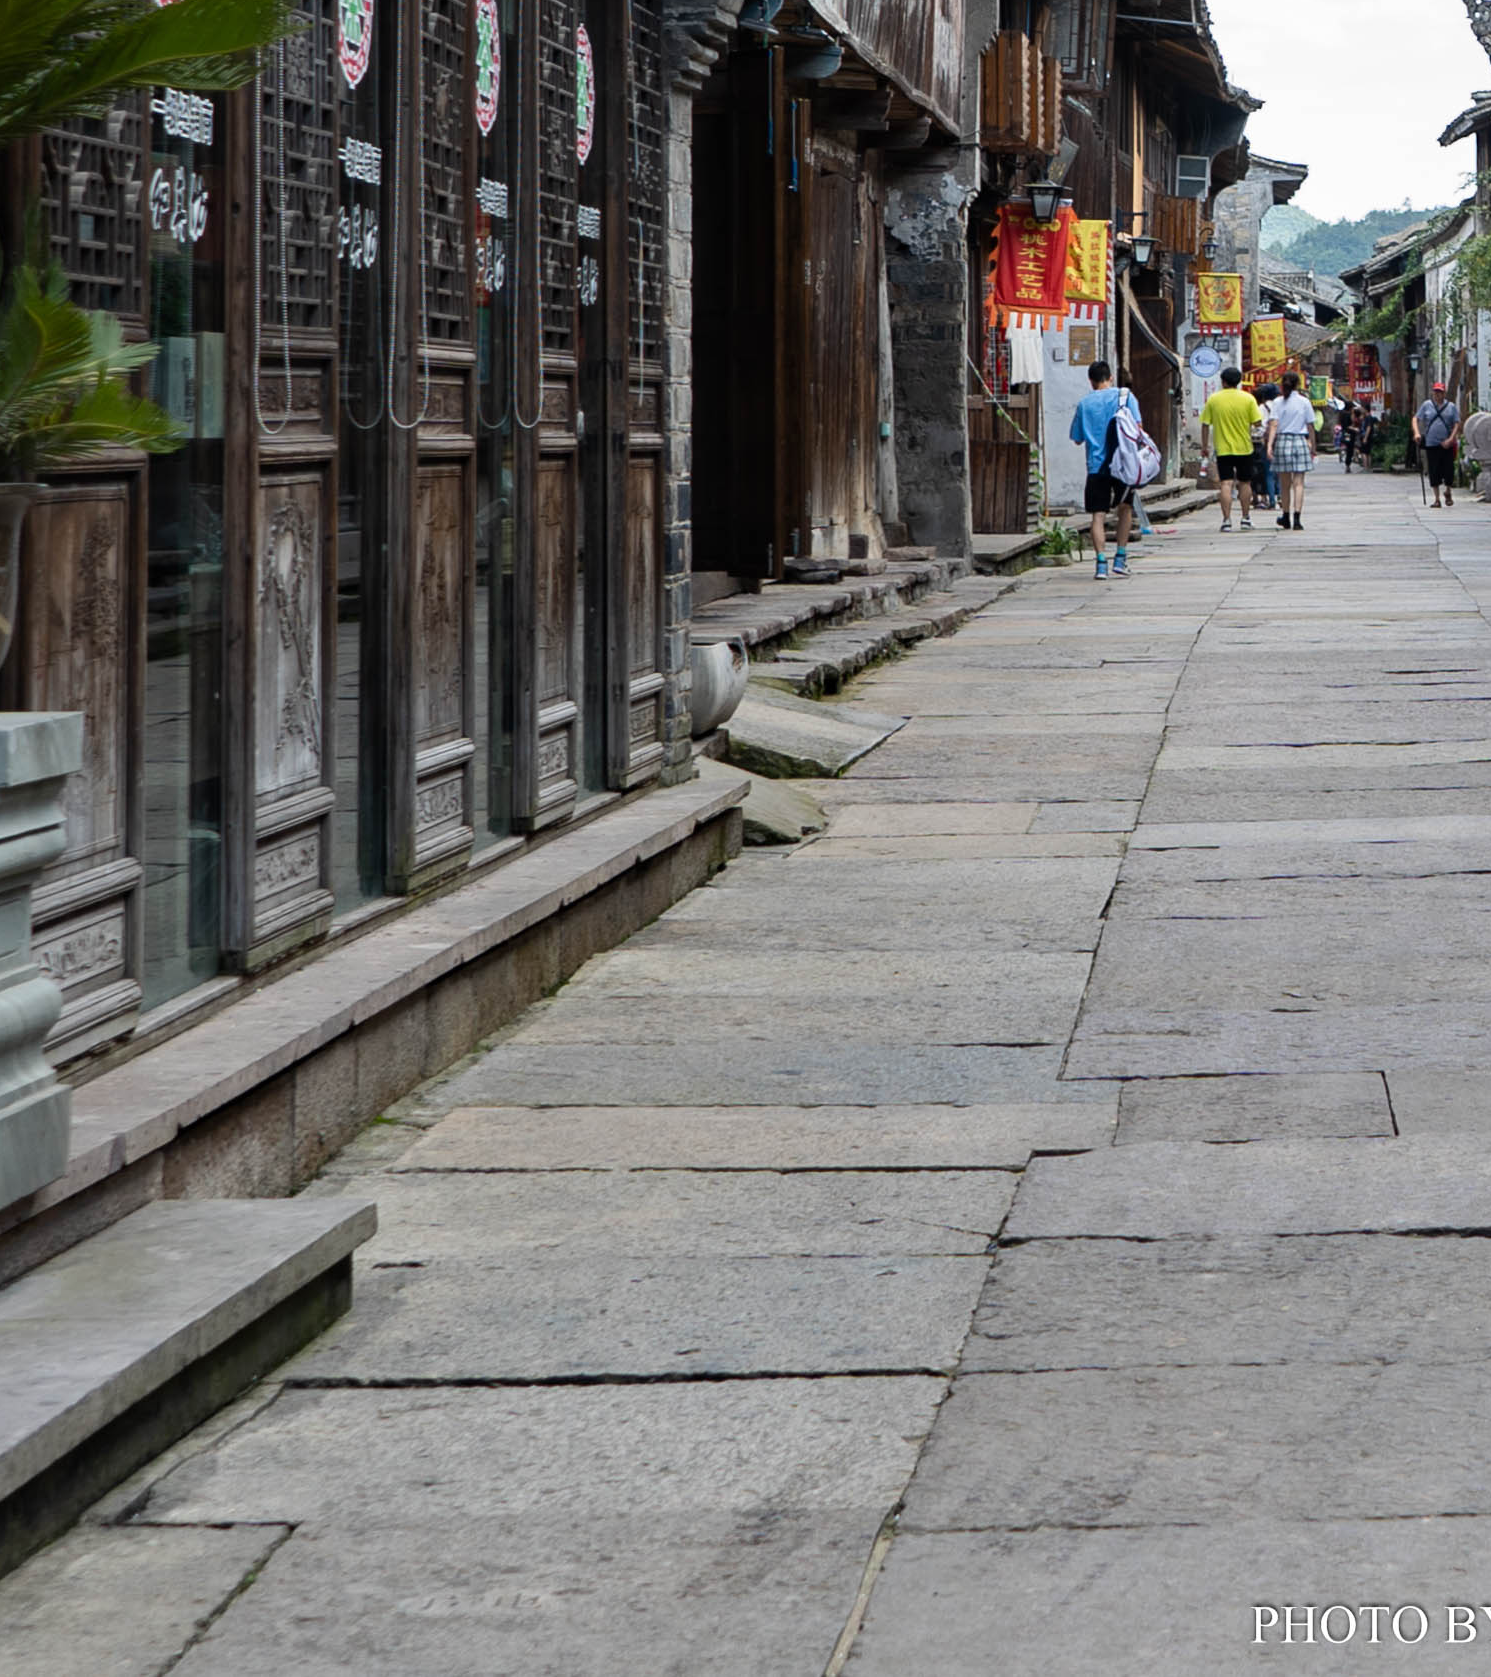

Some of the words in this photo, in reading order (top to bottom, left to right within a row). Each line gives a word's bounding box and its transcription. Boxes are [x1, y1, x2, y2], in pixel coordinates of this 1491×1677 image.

[1015, 233, 1049, 300] 桃木工艺品
